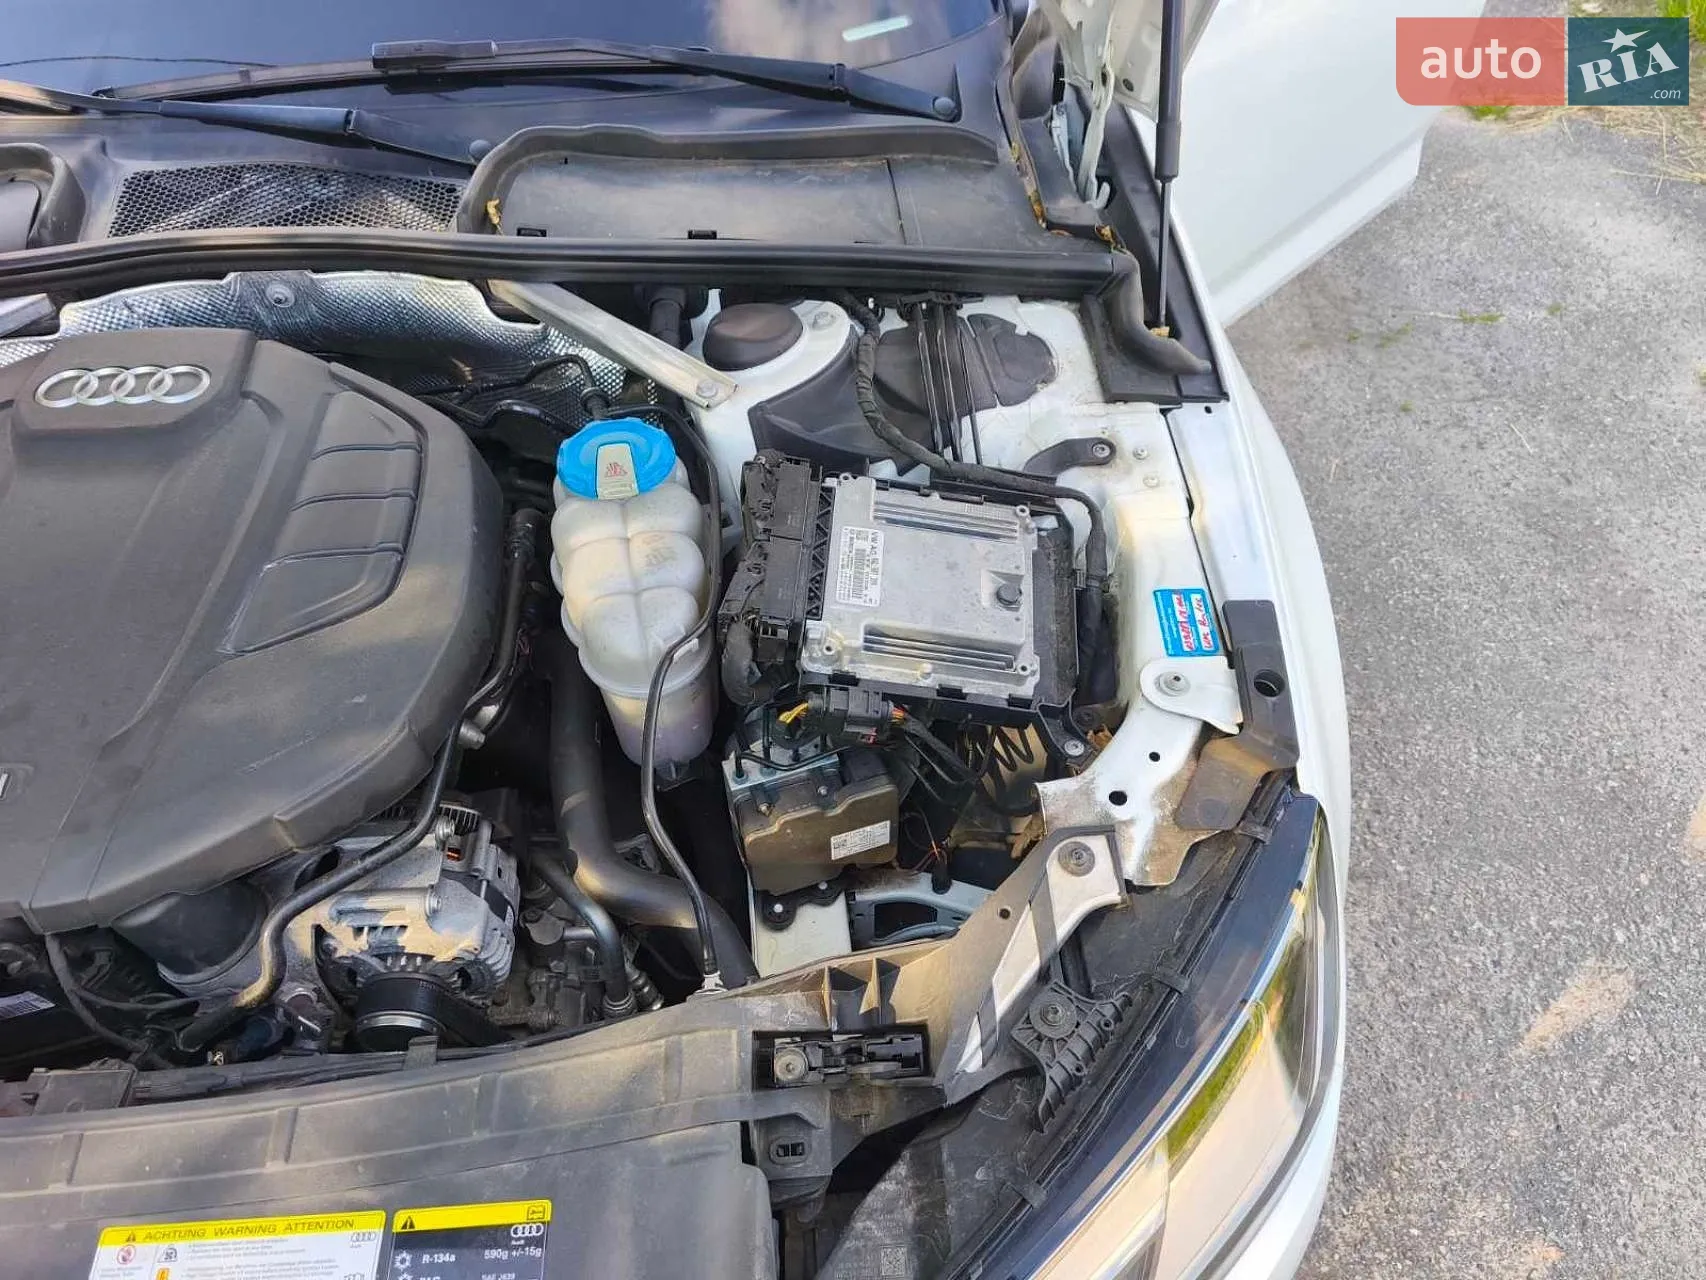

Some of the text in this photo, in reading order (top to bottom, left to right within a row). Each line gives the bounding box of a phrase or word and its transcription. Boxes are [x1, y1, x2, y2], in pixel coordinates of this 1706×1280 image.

[144, 1218, 355, 1242] ACHTUNG WARNING ATTENTION
[422, 1252, 456, 1264] R-134a
[484, 1246, 542, 1260] 590g +/-15g
